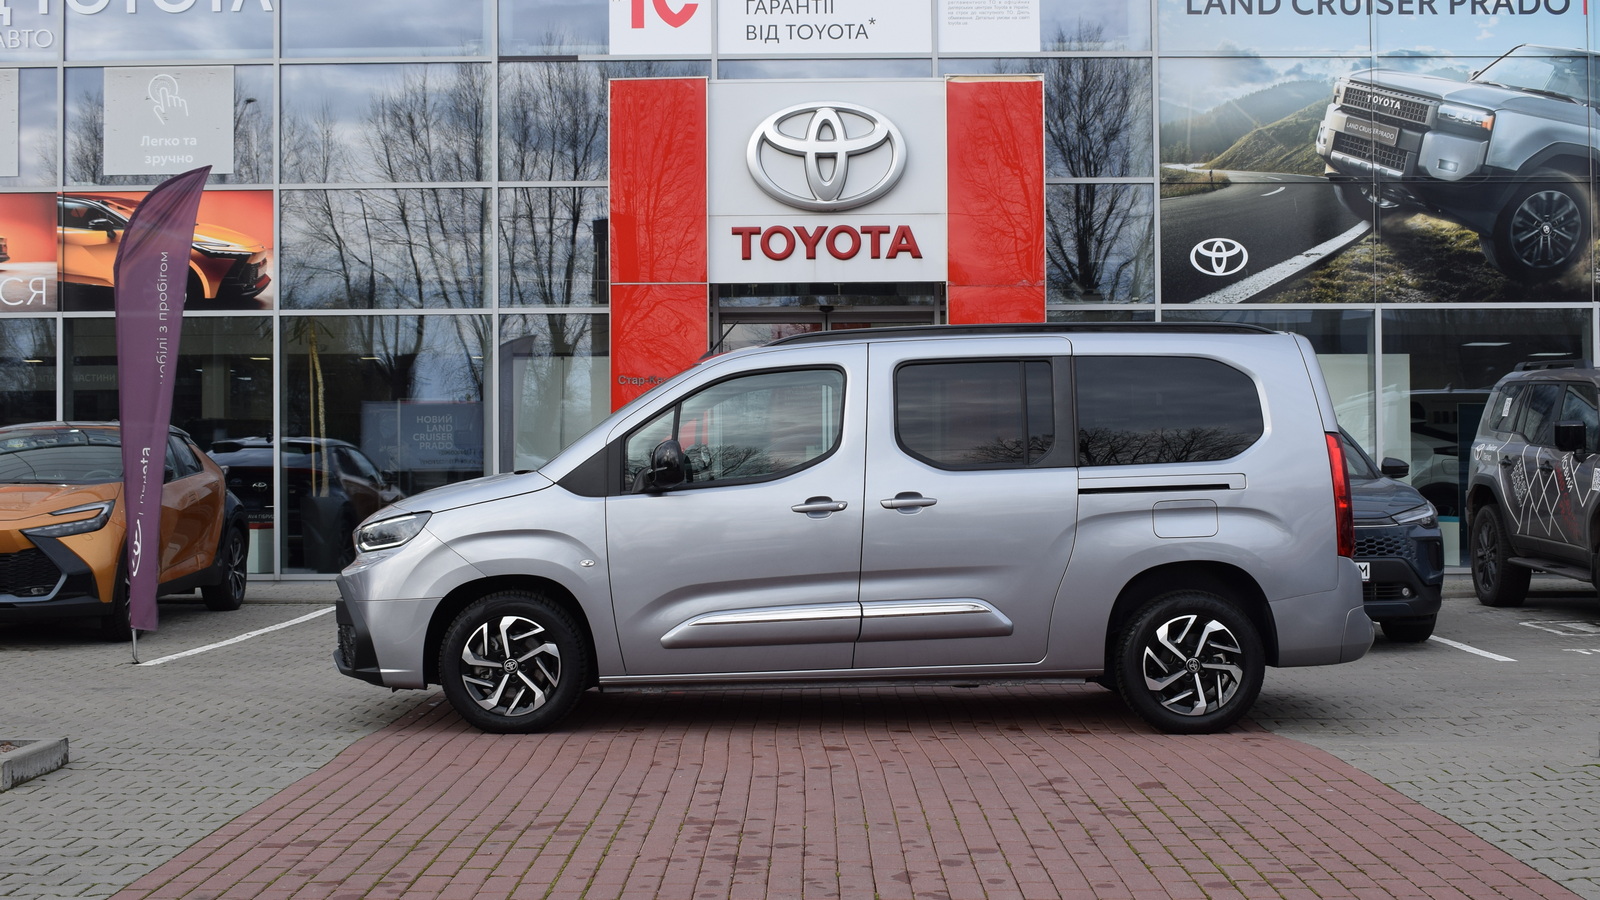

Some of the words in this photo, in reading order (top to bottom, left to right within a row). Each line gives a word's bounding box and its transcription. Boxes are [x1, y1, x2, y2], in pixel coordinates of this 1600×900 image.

[746, 24, 780, 44] ВІД
[1366, 94, 1401, 110] TOYOTA
[1346, 122, 1359, 131] LAND
[140, 135, 181, 149] Легко
[183, 137, 197, 147] та
[145, 152, 194, 166] зручно
[731, 225, 923, 261] TOYOTA
[155, 251, 169, 320] пробігом
[416, 414, 453, 424] НОВИЙ
[426, 424, 453, 433] LAND
[413, 433, 453, 441] CRUISER
[419, 442, 453, 450] PRADO
